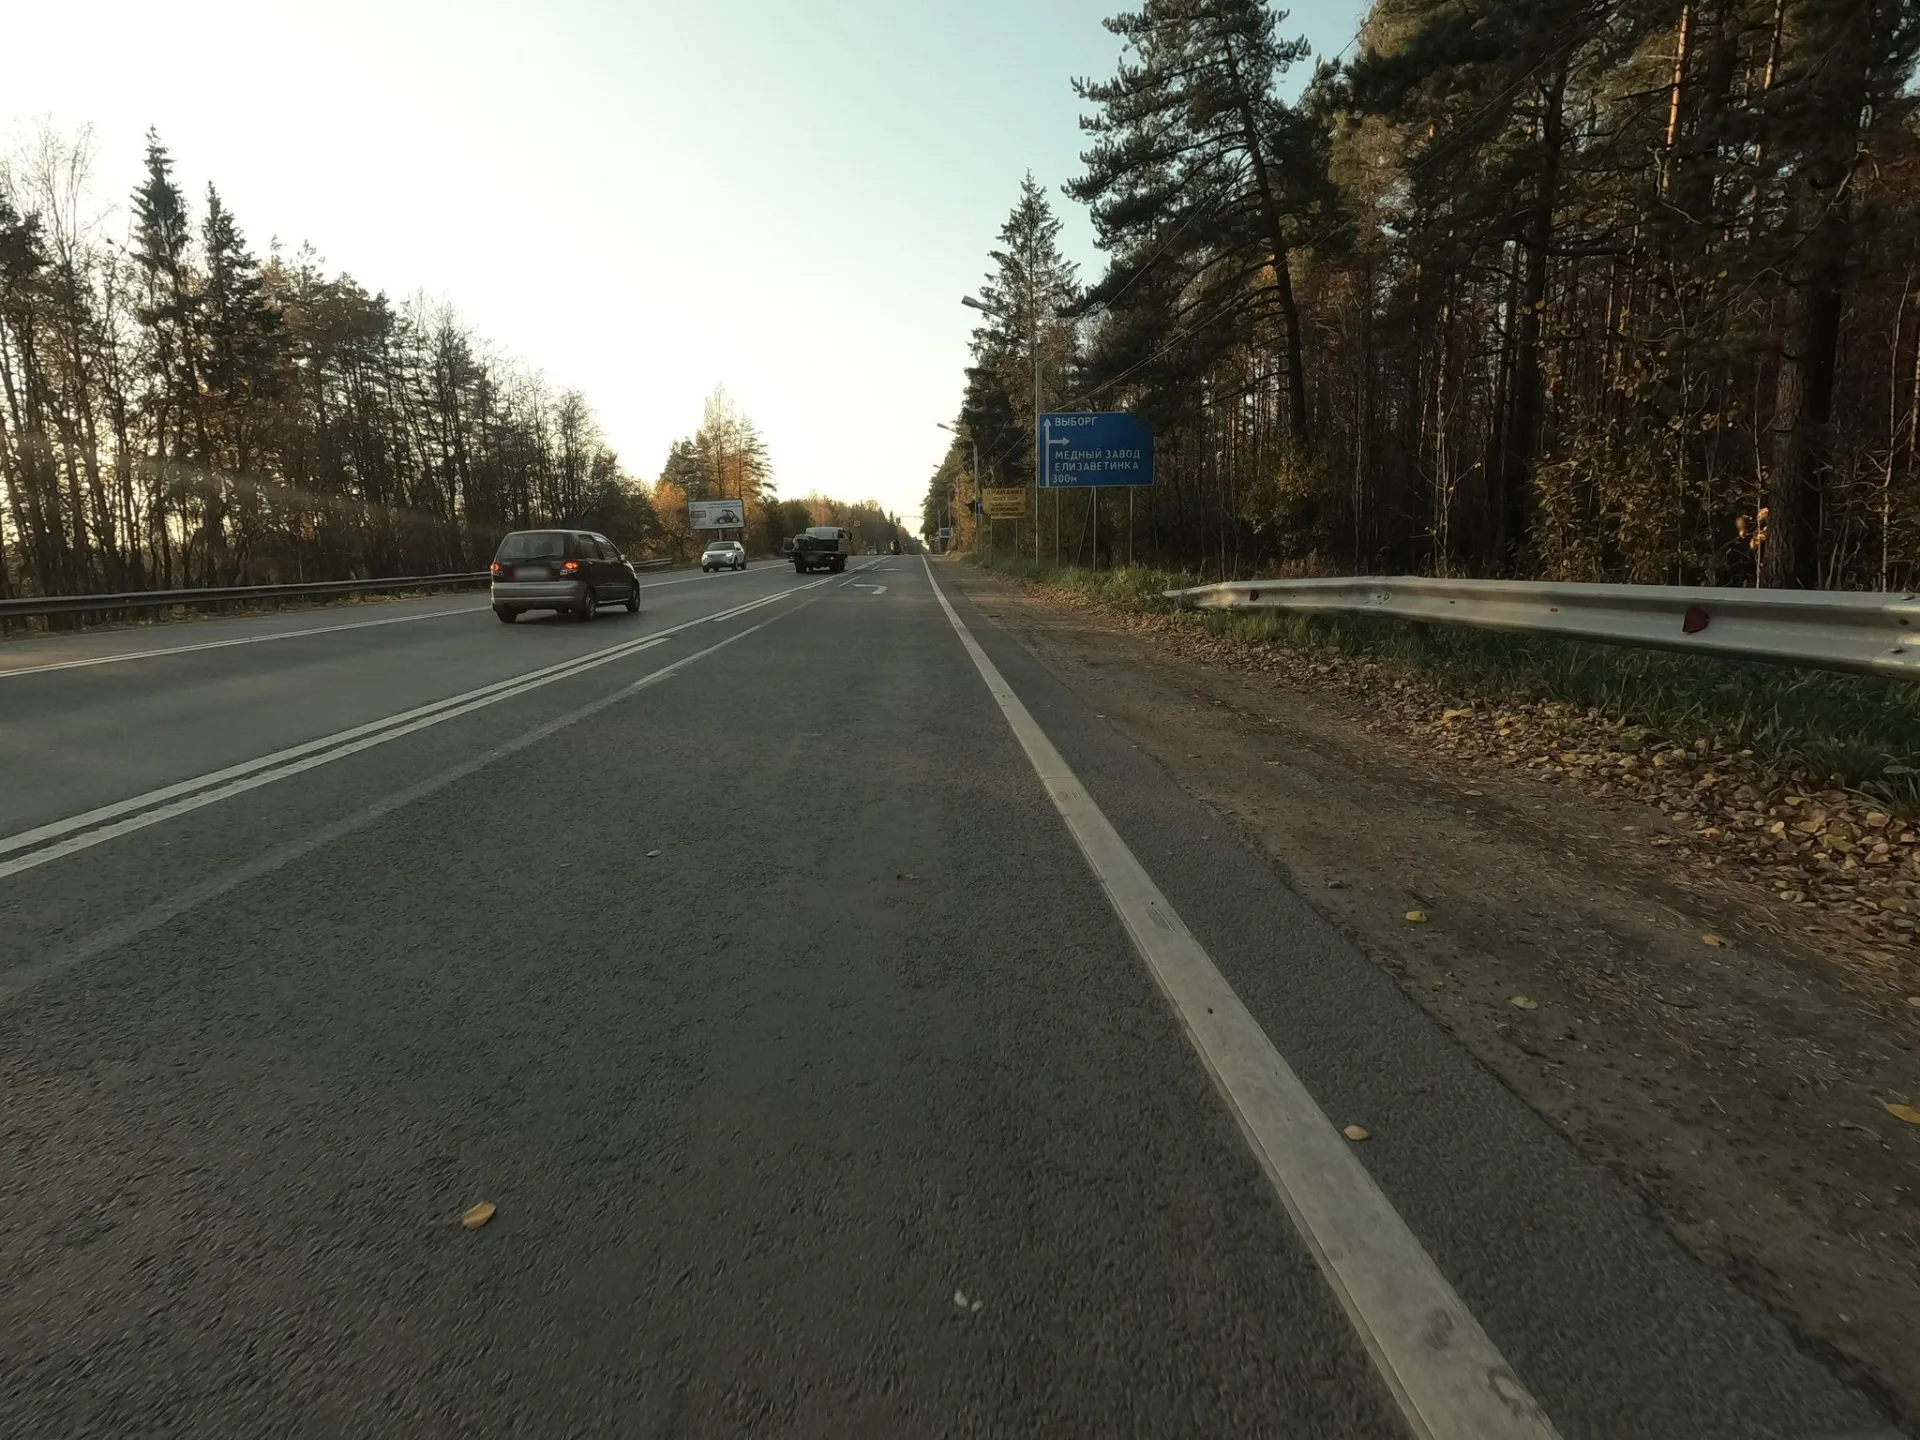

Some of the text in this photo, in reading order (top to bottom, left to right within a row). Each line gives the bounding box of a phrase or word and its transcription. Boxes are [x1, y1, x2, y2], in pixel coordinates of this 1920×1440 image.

[1054, 416, 1098, 427] ВЫБОРГ
[1055, 449, 1141, 460] МЕДНЫЙ ЗАВОД
[1054, 461, 1140, 472] ЕЛИЗАВЕТИНКА
